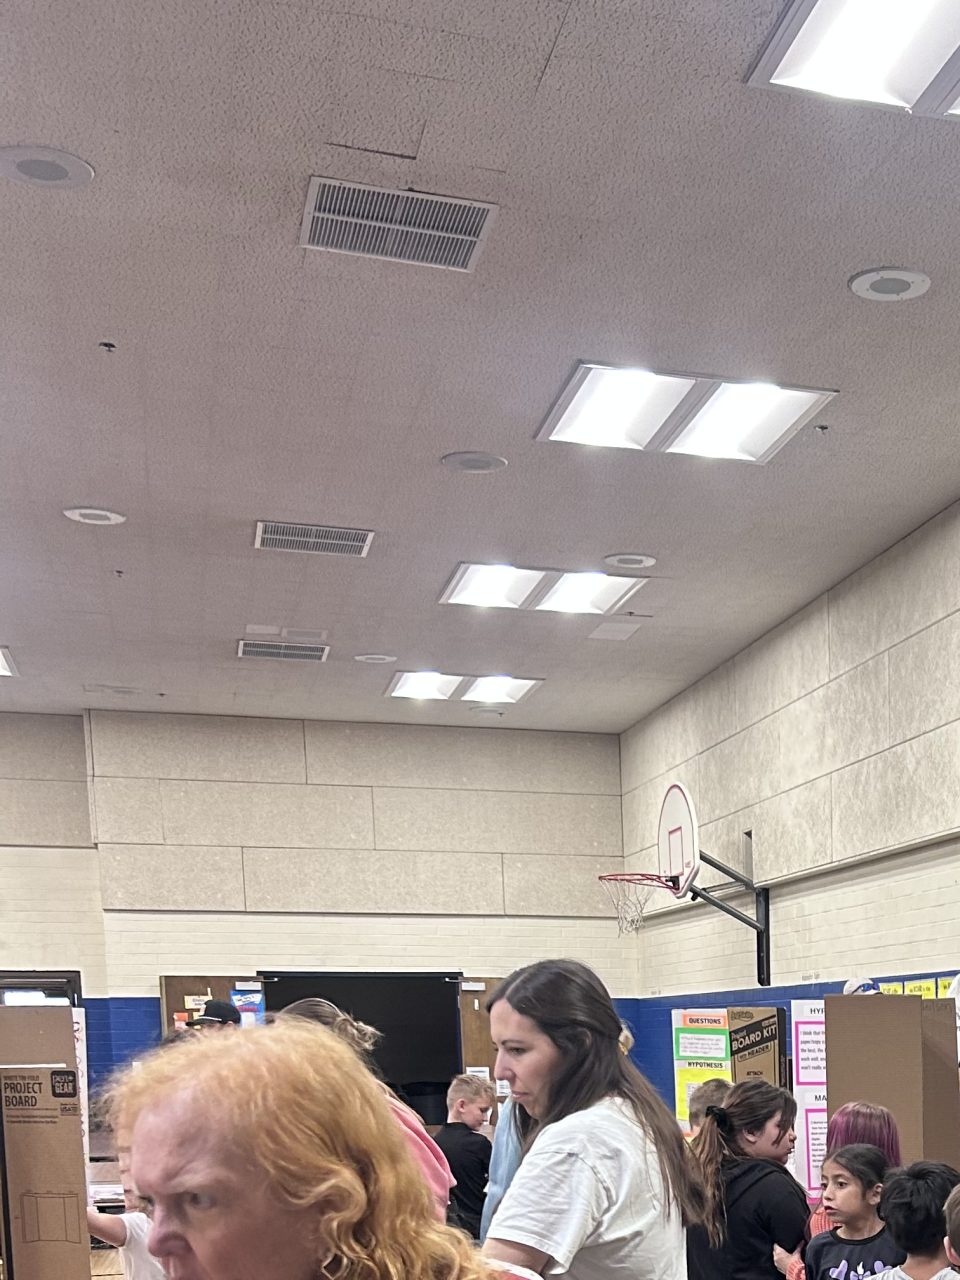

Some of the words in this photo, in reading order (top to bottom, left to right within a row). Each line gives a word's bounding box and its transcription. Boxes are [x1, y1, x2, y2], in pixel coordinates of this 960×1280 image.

[688, 1017, 722, 1025] QUESTIONS
[732, 1031, 762, 1051] BOARD
[763, 1025, 777, 1038] KIT
[747, 1044, 770, 1057] HEADER
[687, 1061, 723, 1069] HYPOTHESIS
[4, 1082, 43, 1094] PROJECT
[55, 1083, 74, 1094] GEAR
[5, 1095, 38, 1107] BOARD
